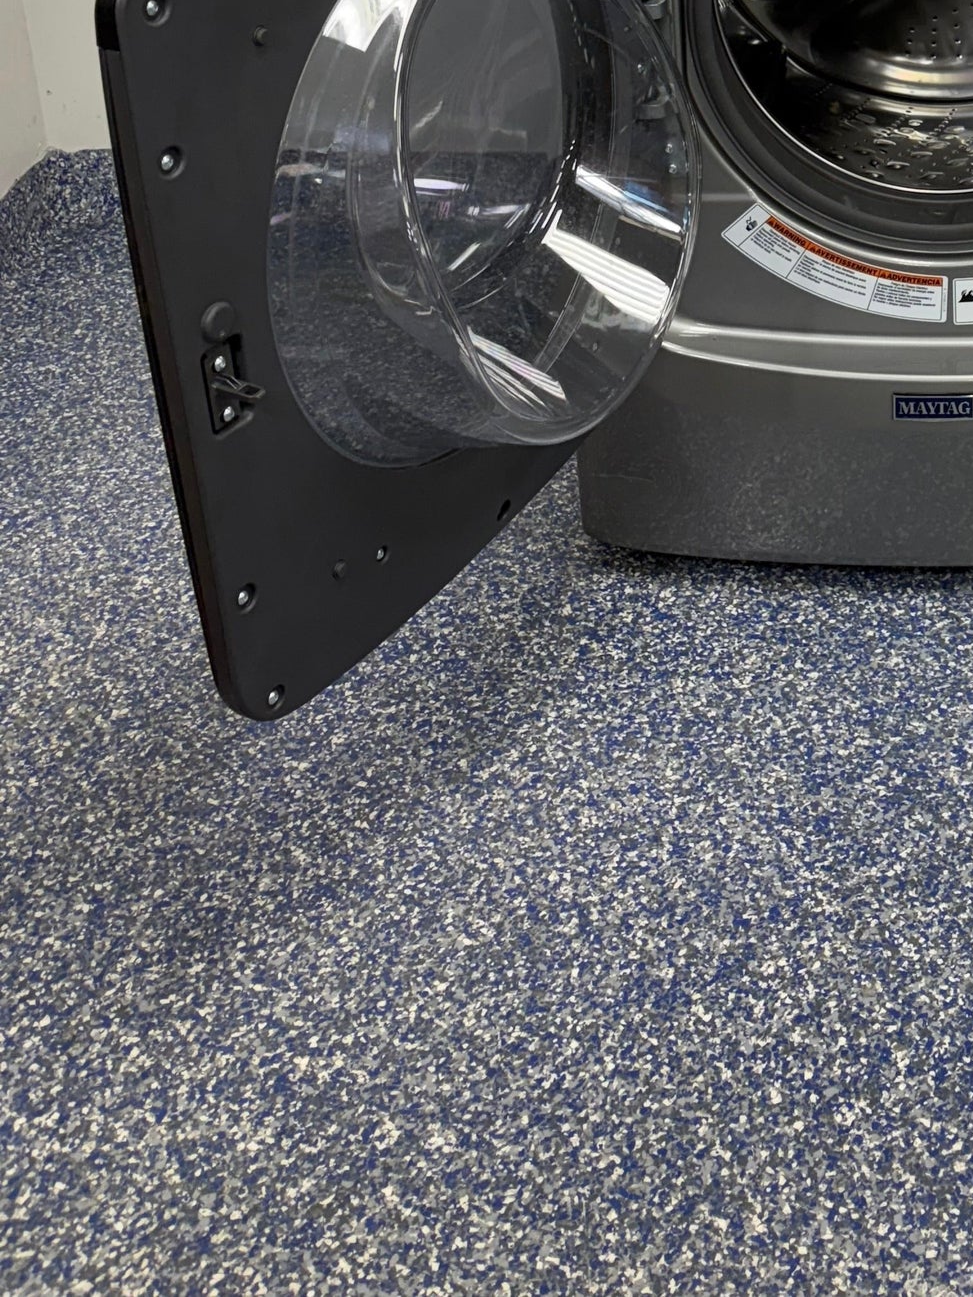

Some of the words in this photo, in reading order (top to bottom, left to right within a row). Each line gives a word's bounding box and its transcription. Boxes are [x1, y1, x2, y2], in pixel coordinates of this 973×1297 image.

[774, 220, 806, 248] WARNING
[815, 247, 878, 276] AVERTISSEMENT
[887, 273, 941, 285] ADVERTENCIA
[899, 401, 971, 414] MAYTAG
